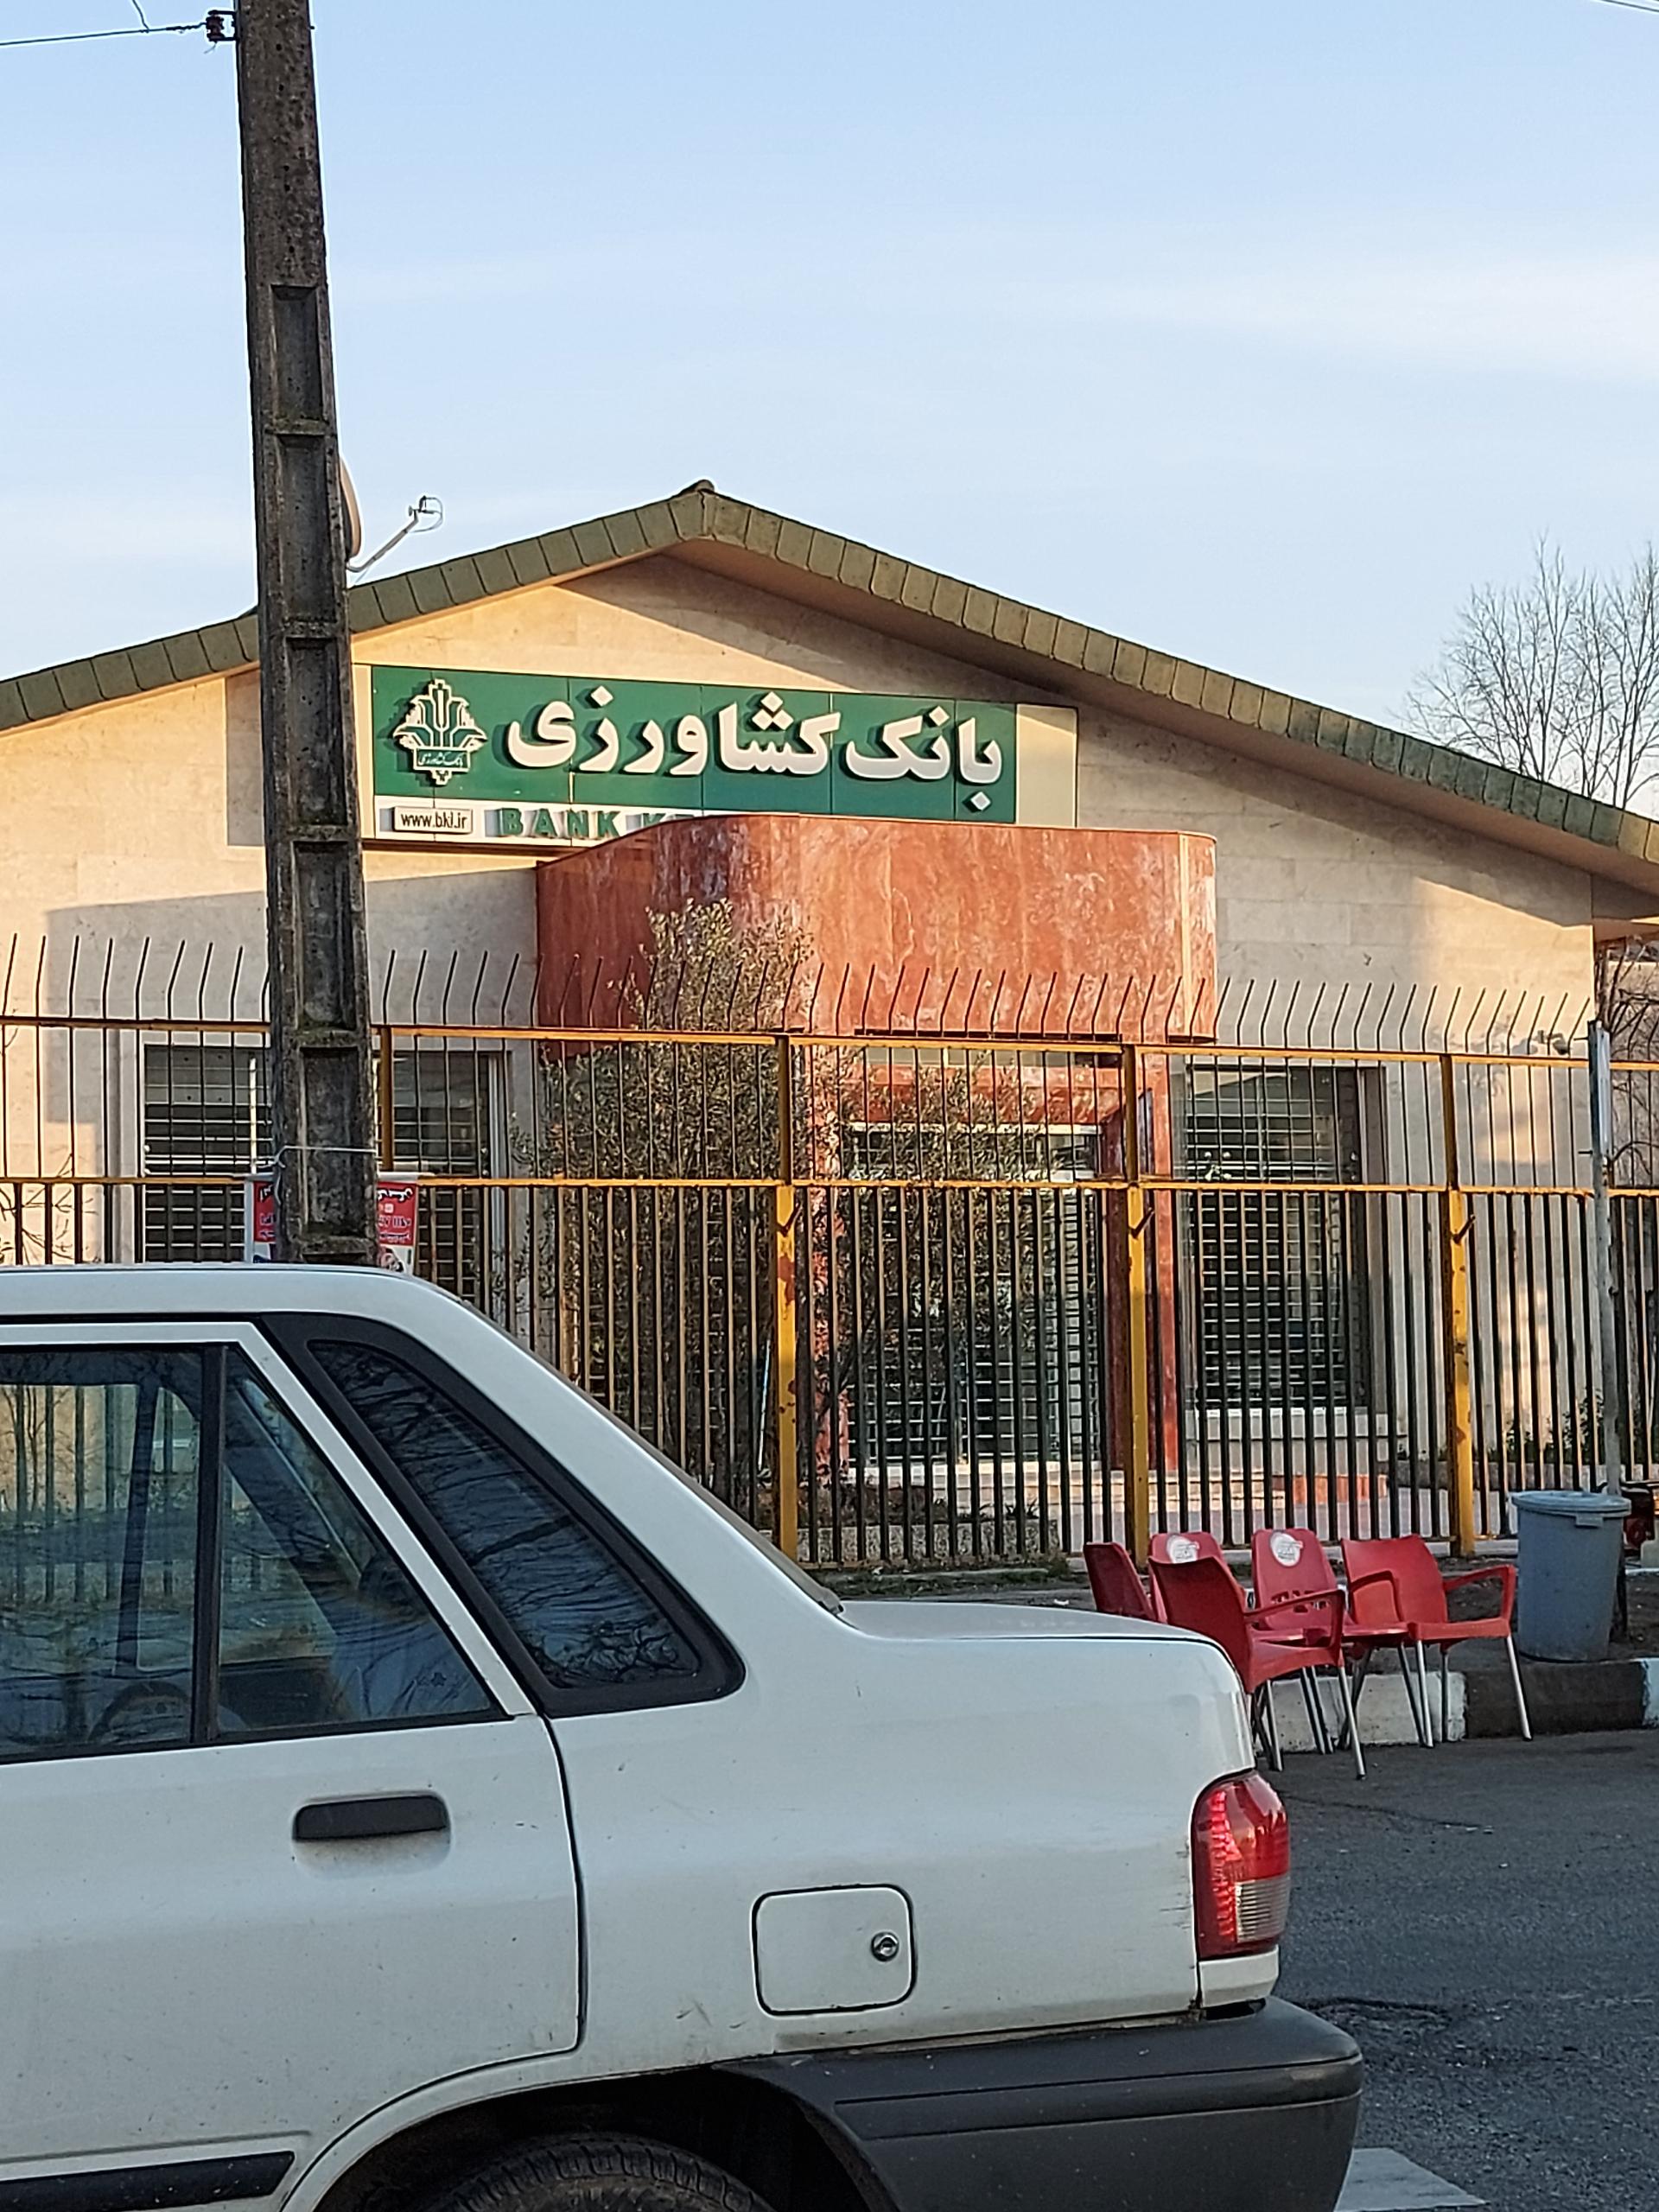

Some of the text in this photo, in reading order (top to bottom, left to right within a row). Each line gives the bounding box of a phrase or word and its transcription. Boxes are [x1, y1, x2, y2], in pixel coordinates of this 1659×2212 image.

[507, 686, 1002, 811] بانک کشاورزی
[500, 807, 620, 839] BANK
